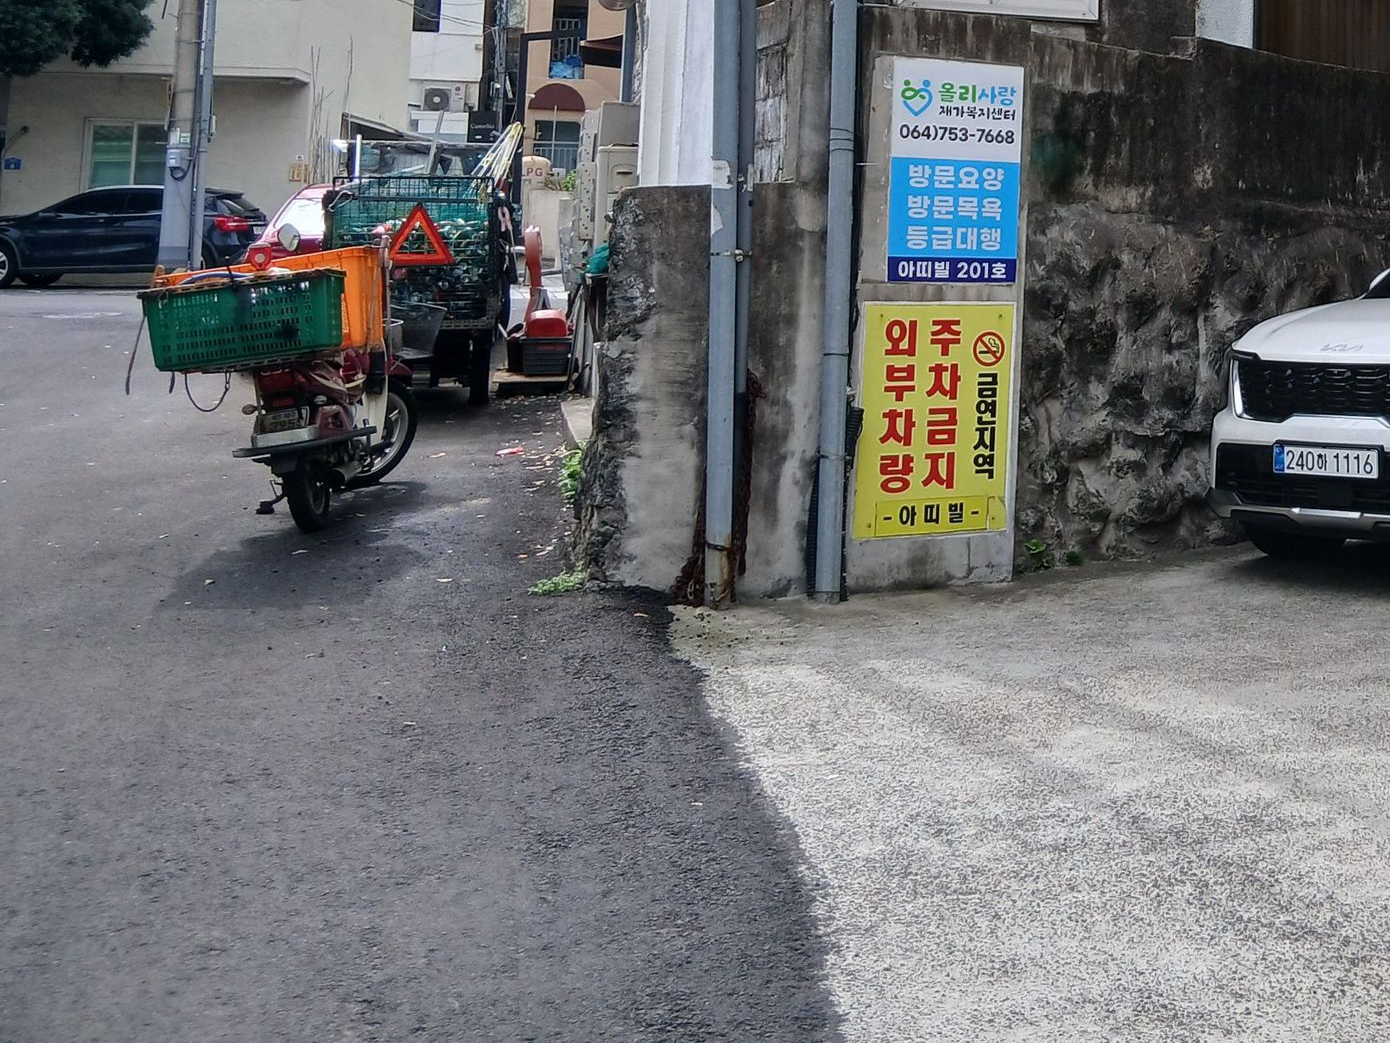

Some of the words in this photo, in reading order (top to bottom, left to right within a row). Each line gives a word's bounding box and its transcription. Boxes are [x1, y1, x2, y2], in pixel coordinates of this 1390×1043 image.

[938, 82, 1017, 107] 올리사랑
[938, 106, 1016, 121] 재가복지센터
[899, 124, 1015, 145] 064)753-7668
[908, 164, 1005, 191] 방문요양
[907, 195, 1003, 221] 방문목욕
[906, 226, 1002, 251] 등급대행
[897, 261, 950, 279] 아띠빌
[956, 261, 1007, 279] 201호
[878, 319, 918, 494] 외부차량
[921, 319, 962, 490] 주차금지
[973, 372, 998, 479] 금연지역
[1333, 453, 1374, 475] 1116
[899, 502, 965, 526] 아띠빌
